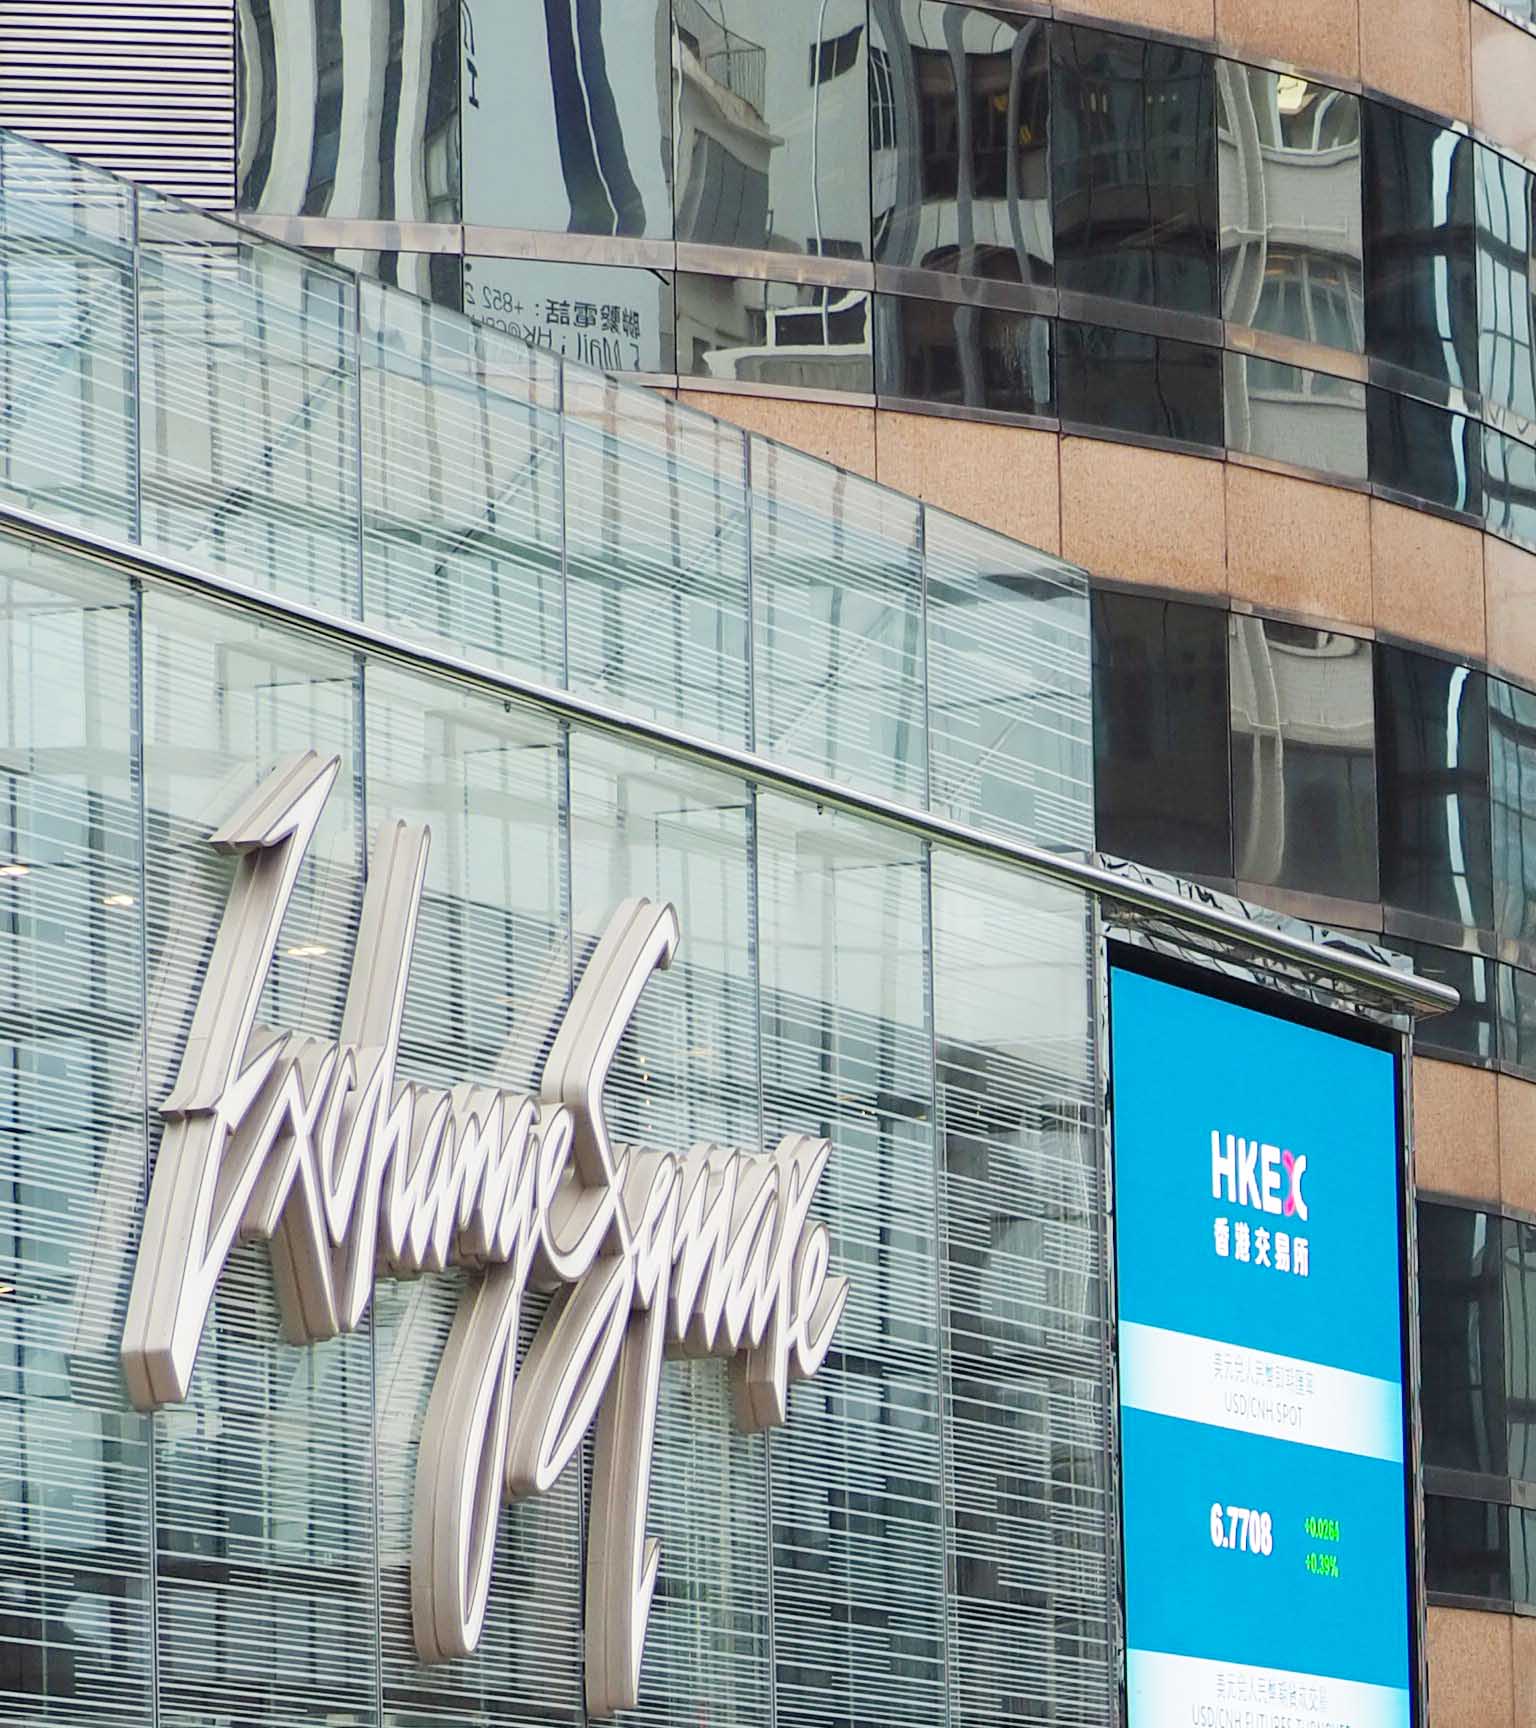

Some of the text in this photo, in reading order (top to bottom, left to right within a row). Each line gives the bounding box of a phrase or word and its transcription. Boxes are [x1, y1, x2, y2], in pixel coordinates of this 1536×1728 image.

[1210, 1129, 1308, 1221] HKEX
[1213, 1216, 1311, 1278] 香港交易所
[1209, 1502, 1273, 1556] 6.7708
